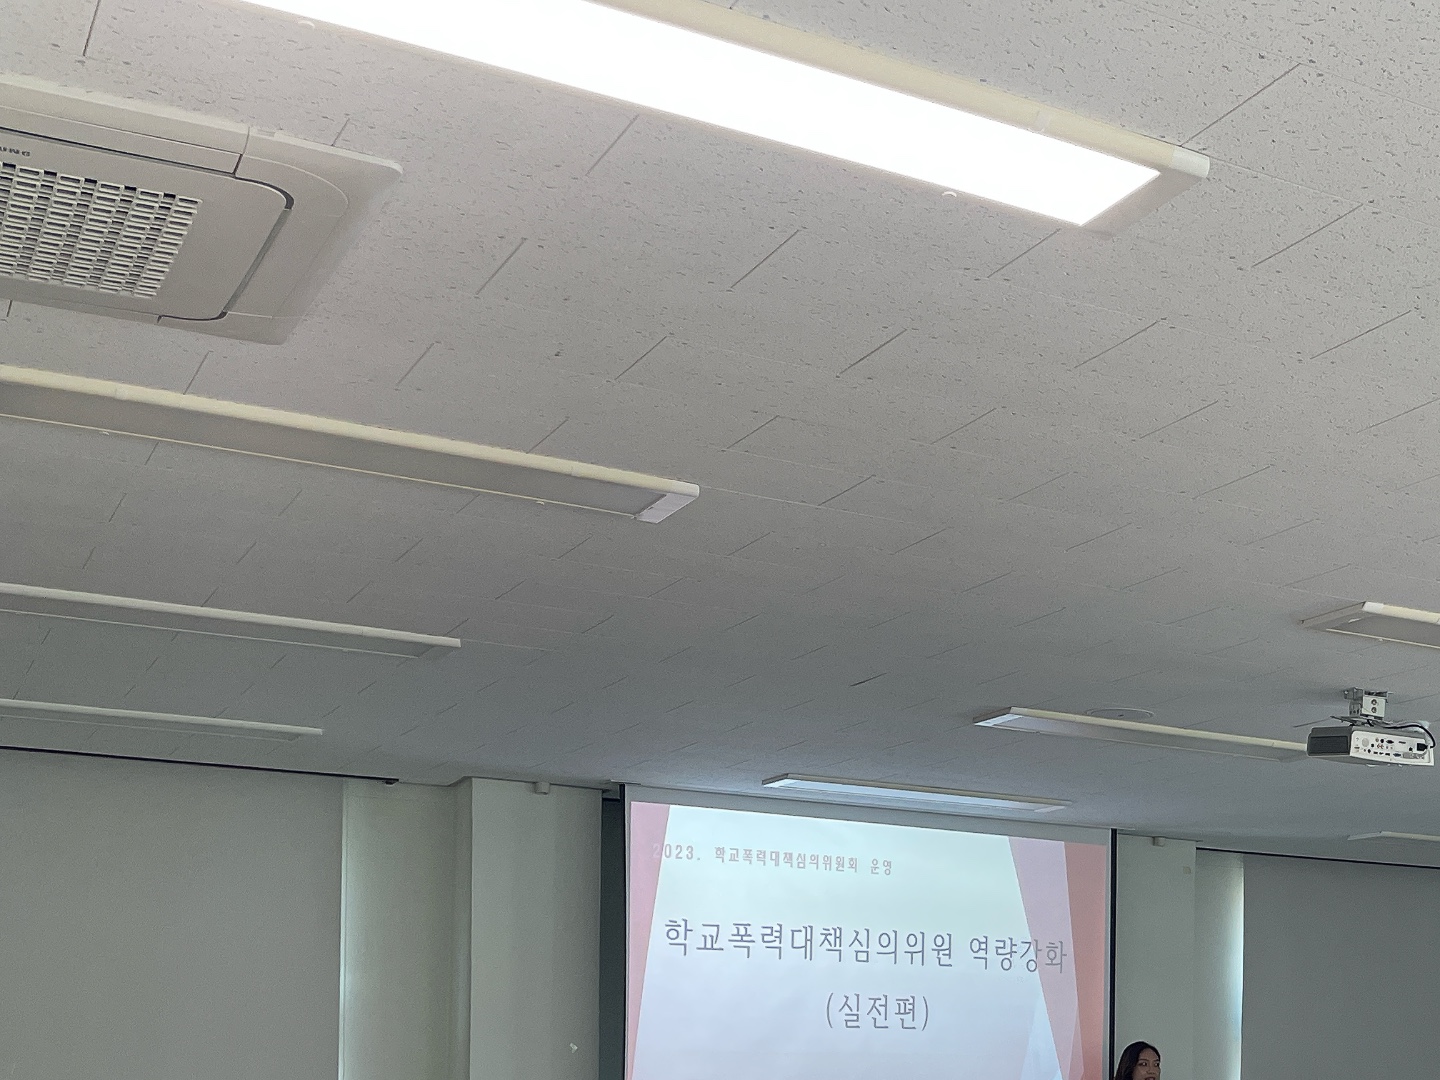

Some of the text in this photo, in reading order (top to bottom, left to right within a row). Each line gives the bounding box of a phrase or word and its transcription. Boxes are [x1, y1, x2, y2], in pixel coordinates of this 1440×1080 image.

[652, 843, 893, 876] 2023. 학교폭력대책심의위원회 운영
[664, 918, 1068, 974] 학교폭력대책심의위원 역량강화
[826, 992, 929, 1031] (실전편)
